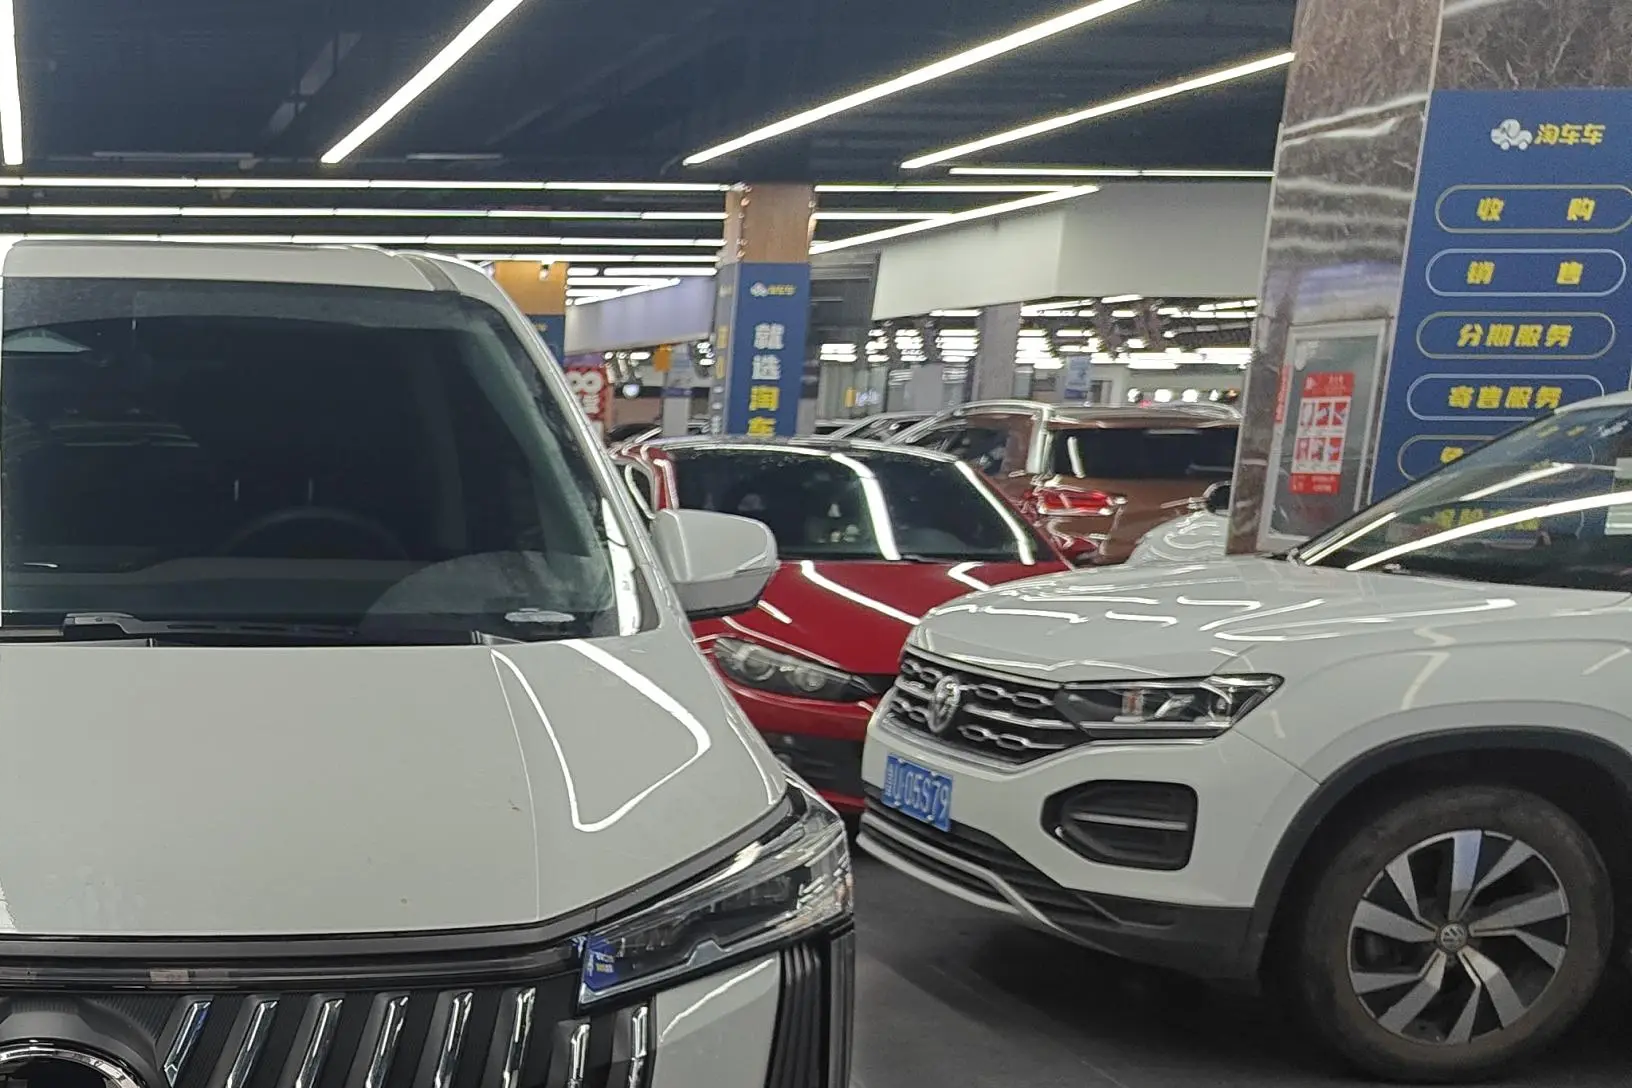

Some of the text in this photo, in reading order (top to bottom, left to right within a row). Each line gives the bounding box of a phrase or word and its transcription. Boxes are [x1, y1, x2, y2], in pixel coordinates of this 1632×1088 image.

[1534, 123, 1606, 145] 淘车车
[1456, 323, 1573, 347] 分期服务
